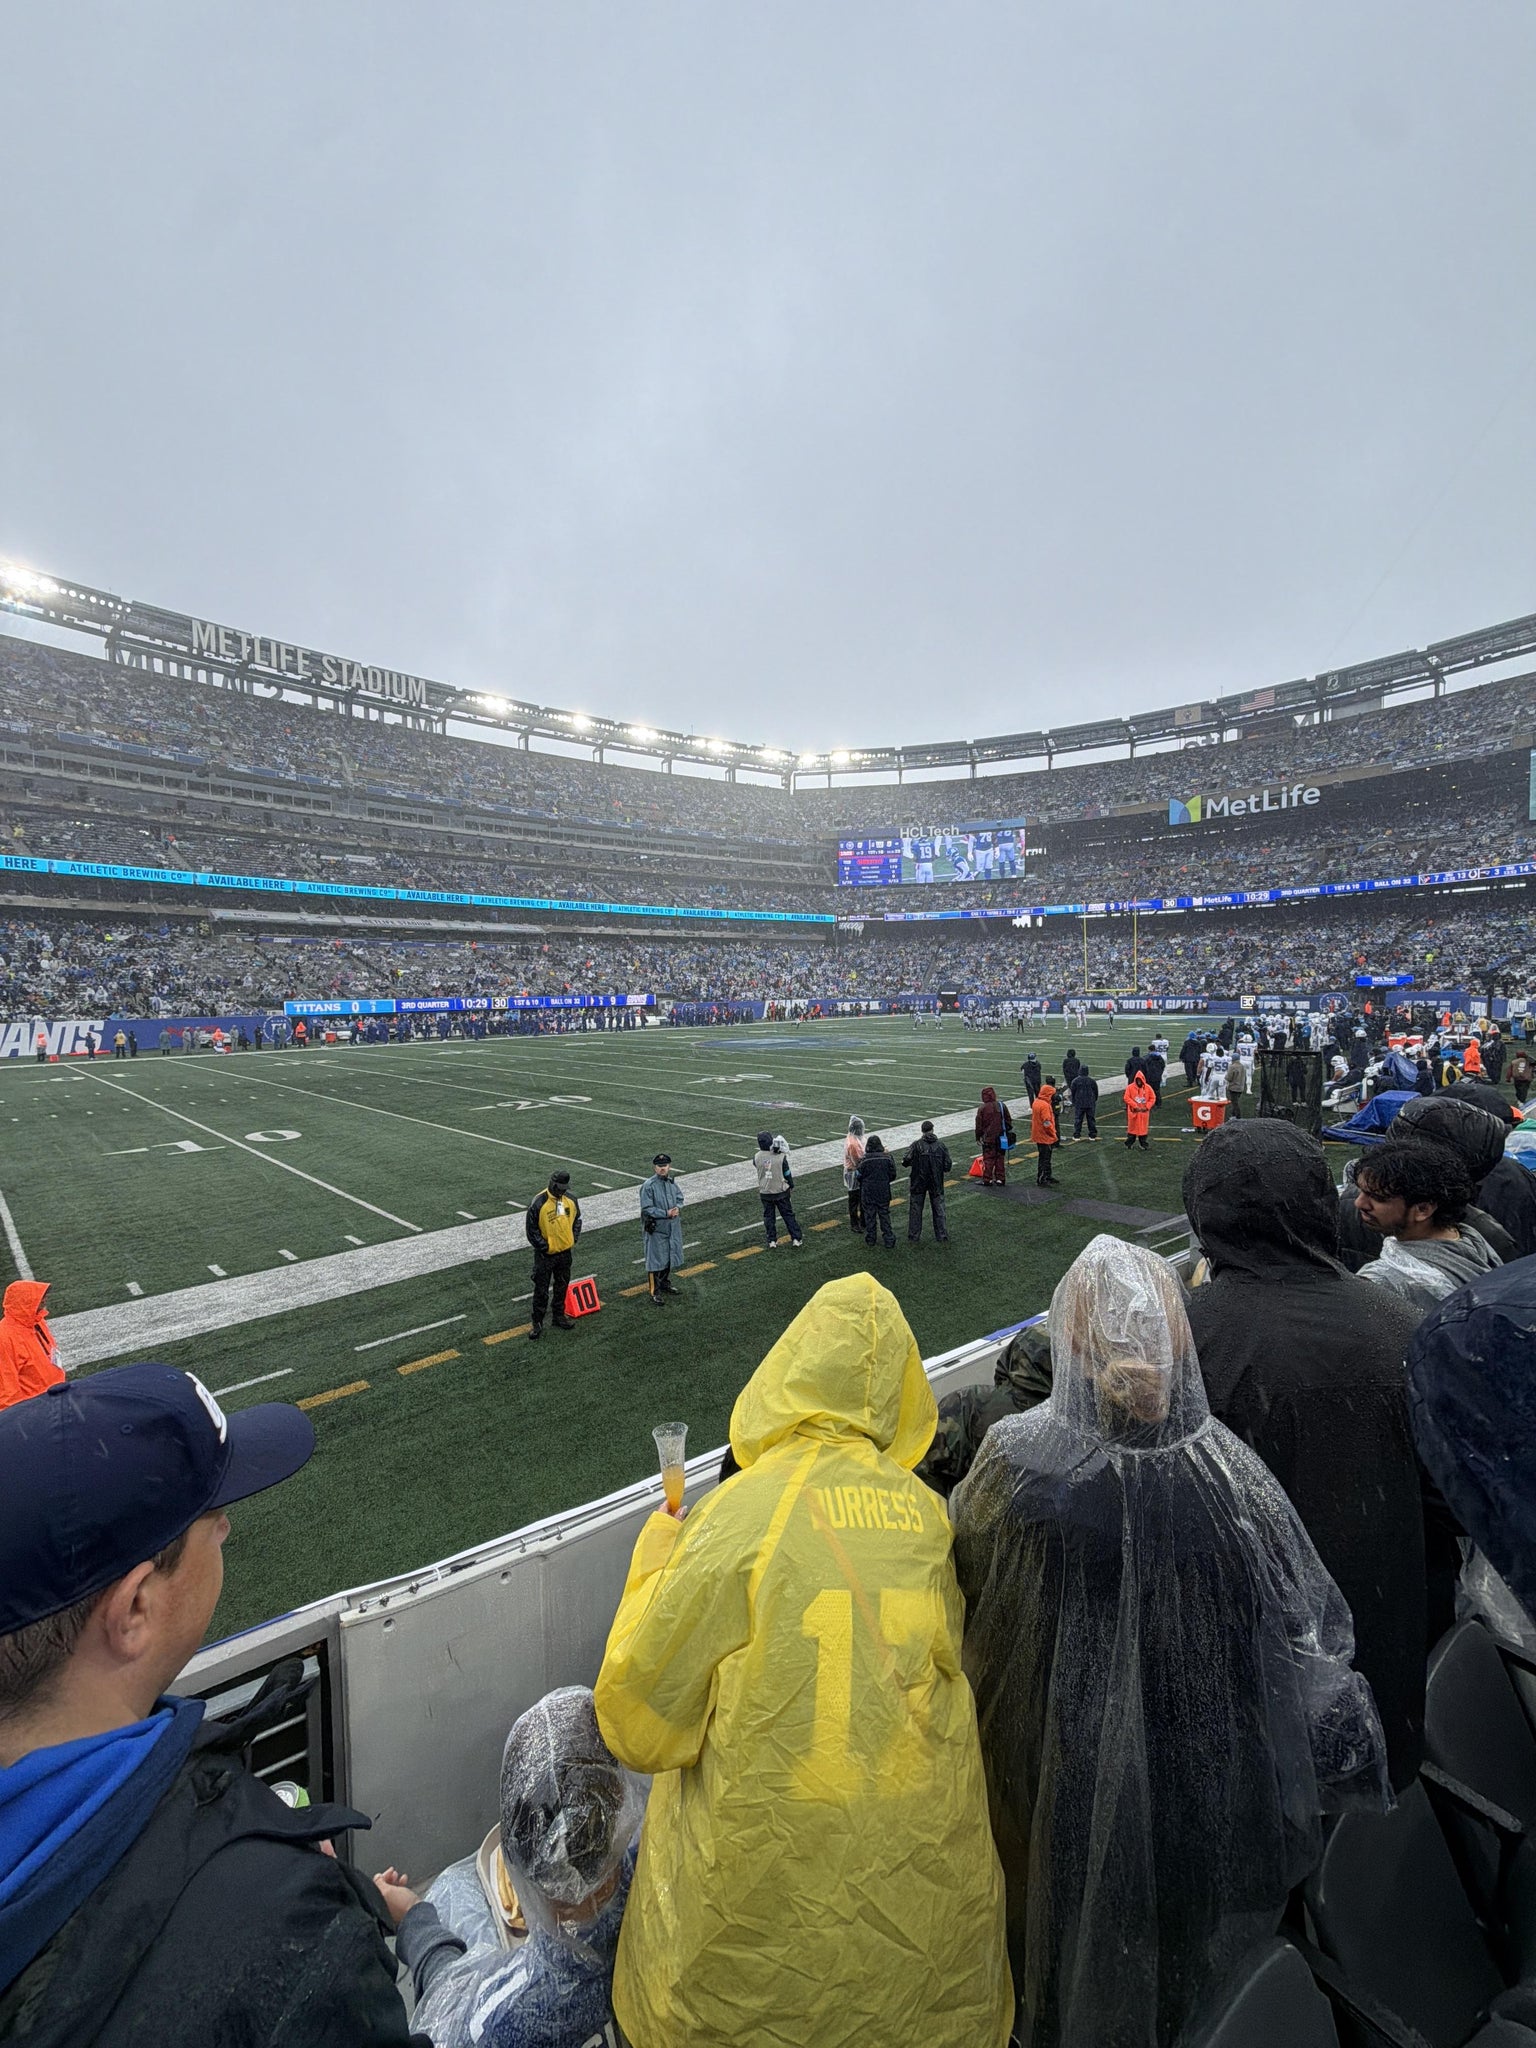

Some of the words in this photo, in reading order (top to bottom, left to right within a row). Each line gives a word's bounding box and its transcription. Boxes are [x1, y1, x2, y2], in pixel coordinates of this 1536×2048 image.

[191, 619, 313, 677] METLIFE
[321, 655, 427, 703] STADIUM
[1206, 783, 1321, 819] MetLife
[900, 825, 959, 838] HCLTech
[920, 846, 932, 859] 19
[4, 857, 38, 870] HERE
[69, 863, 118, 876] ATHLETIC
[122, 868, 167, 880] BREWING
[208, 875, 260, 887] AVAILABLE
[262, 880, 285, 890] HERE
[1374, 880, 1389, 888] BALL
[1390, 879, 1400, 887] ON
[307, 883, 341, 893] ATHLETIC
[344, 886, 376, 896] BREWING
[1281, 889, 1292, 897] 3RD
[1293, 886, 1320, 896] QUARTER
[406, 890, 445, 901] AVAILABLE
[446, 894, 464, 903] HERE
[480, 896, 507, 905] ATHLETIC
[509, 898, 535, 907] BREWING
[1203, 895, 1232, 905] MetLife
[1245, 892, 1269, 901] 10:29
[558, 901, 589, 910] AVAILABLE
[590, 903, 605, 911] HERE
[401, 1001, 416, 1010] 3RD
[417, 1001, 450, 1009] QUARTER
[461, 998, 488, 1009] 10:29
[494, 998, 506, 1008] 30
[610, 996, 616, 1005] 9
[1243, 998, 1253, 1007] 30
[294, 1003, 341, 1012] TITANS
[352, 1001, 359, 1013] 0
[0, 1020, 105, 1057] ANTS
[1240, 1047, 1251, 1056] 51
[1214, 1061, 1228, 1072] 59
[496, 1095, 593, 1111] 20
[1197, 1106, 1211, 1120] G
[573, 1282, 597, 1312] 10
